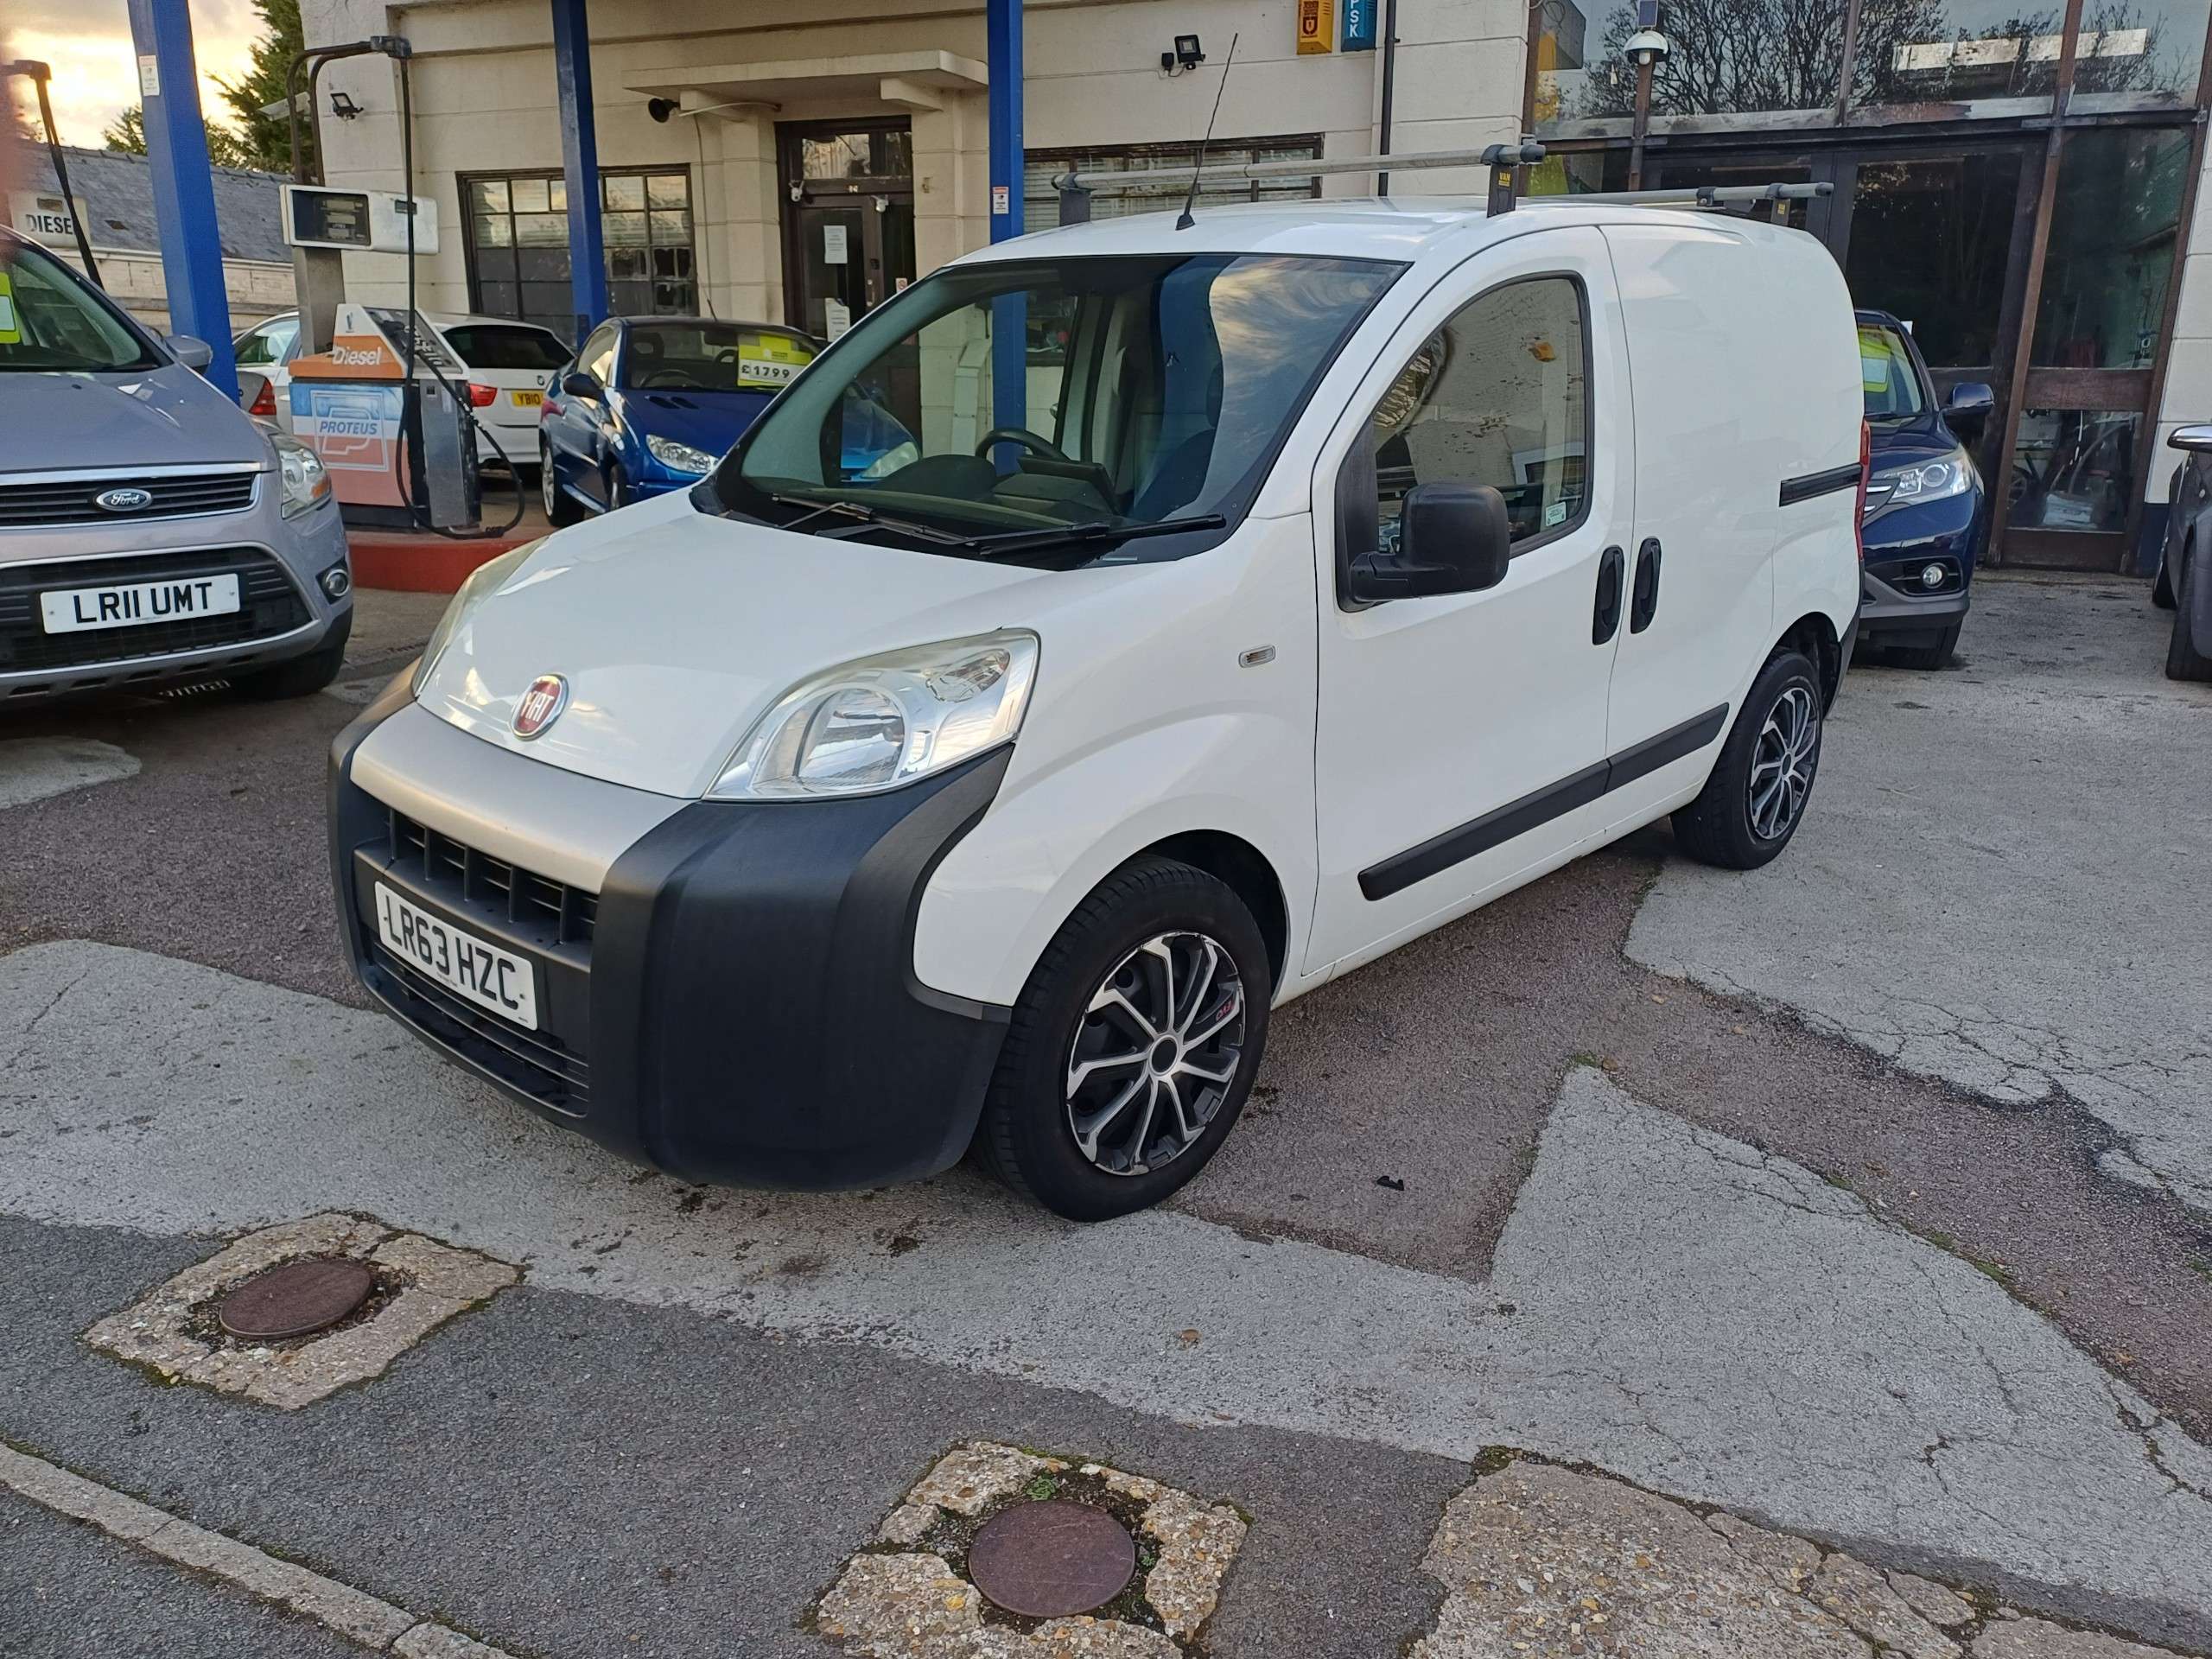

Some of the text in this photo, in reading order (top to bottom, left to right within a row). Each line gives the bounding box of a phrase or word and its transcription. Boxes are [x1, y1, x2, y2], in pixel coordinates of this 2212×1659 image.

[26, 214, 76, 235] DIESE
[333, 346, 381, 365] Diesel
[741, 365, 790, 378] £1799
[320, 421, 378, 435] PROTEUS
[111, 493, 140, 505] Ford
[73, 582, 212, 623] LR11 UMT
[520, 690, 555, 722] FIAT
[386, 895, 518, 1010] LR63 HZC
